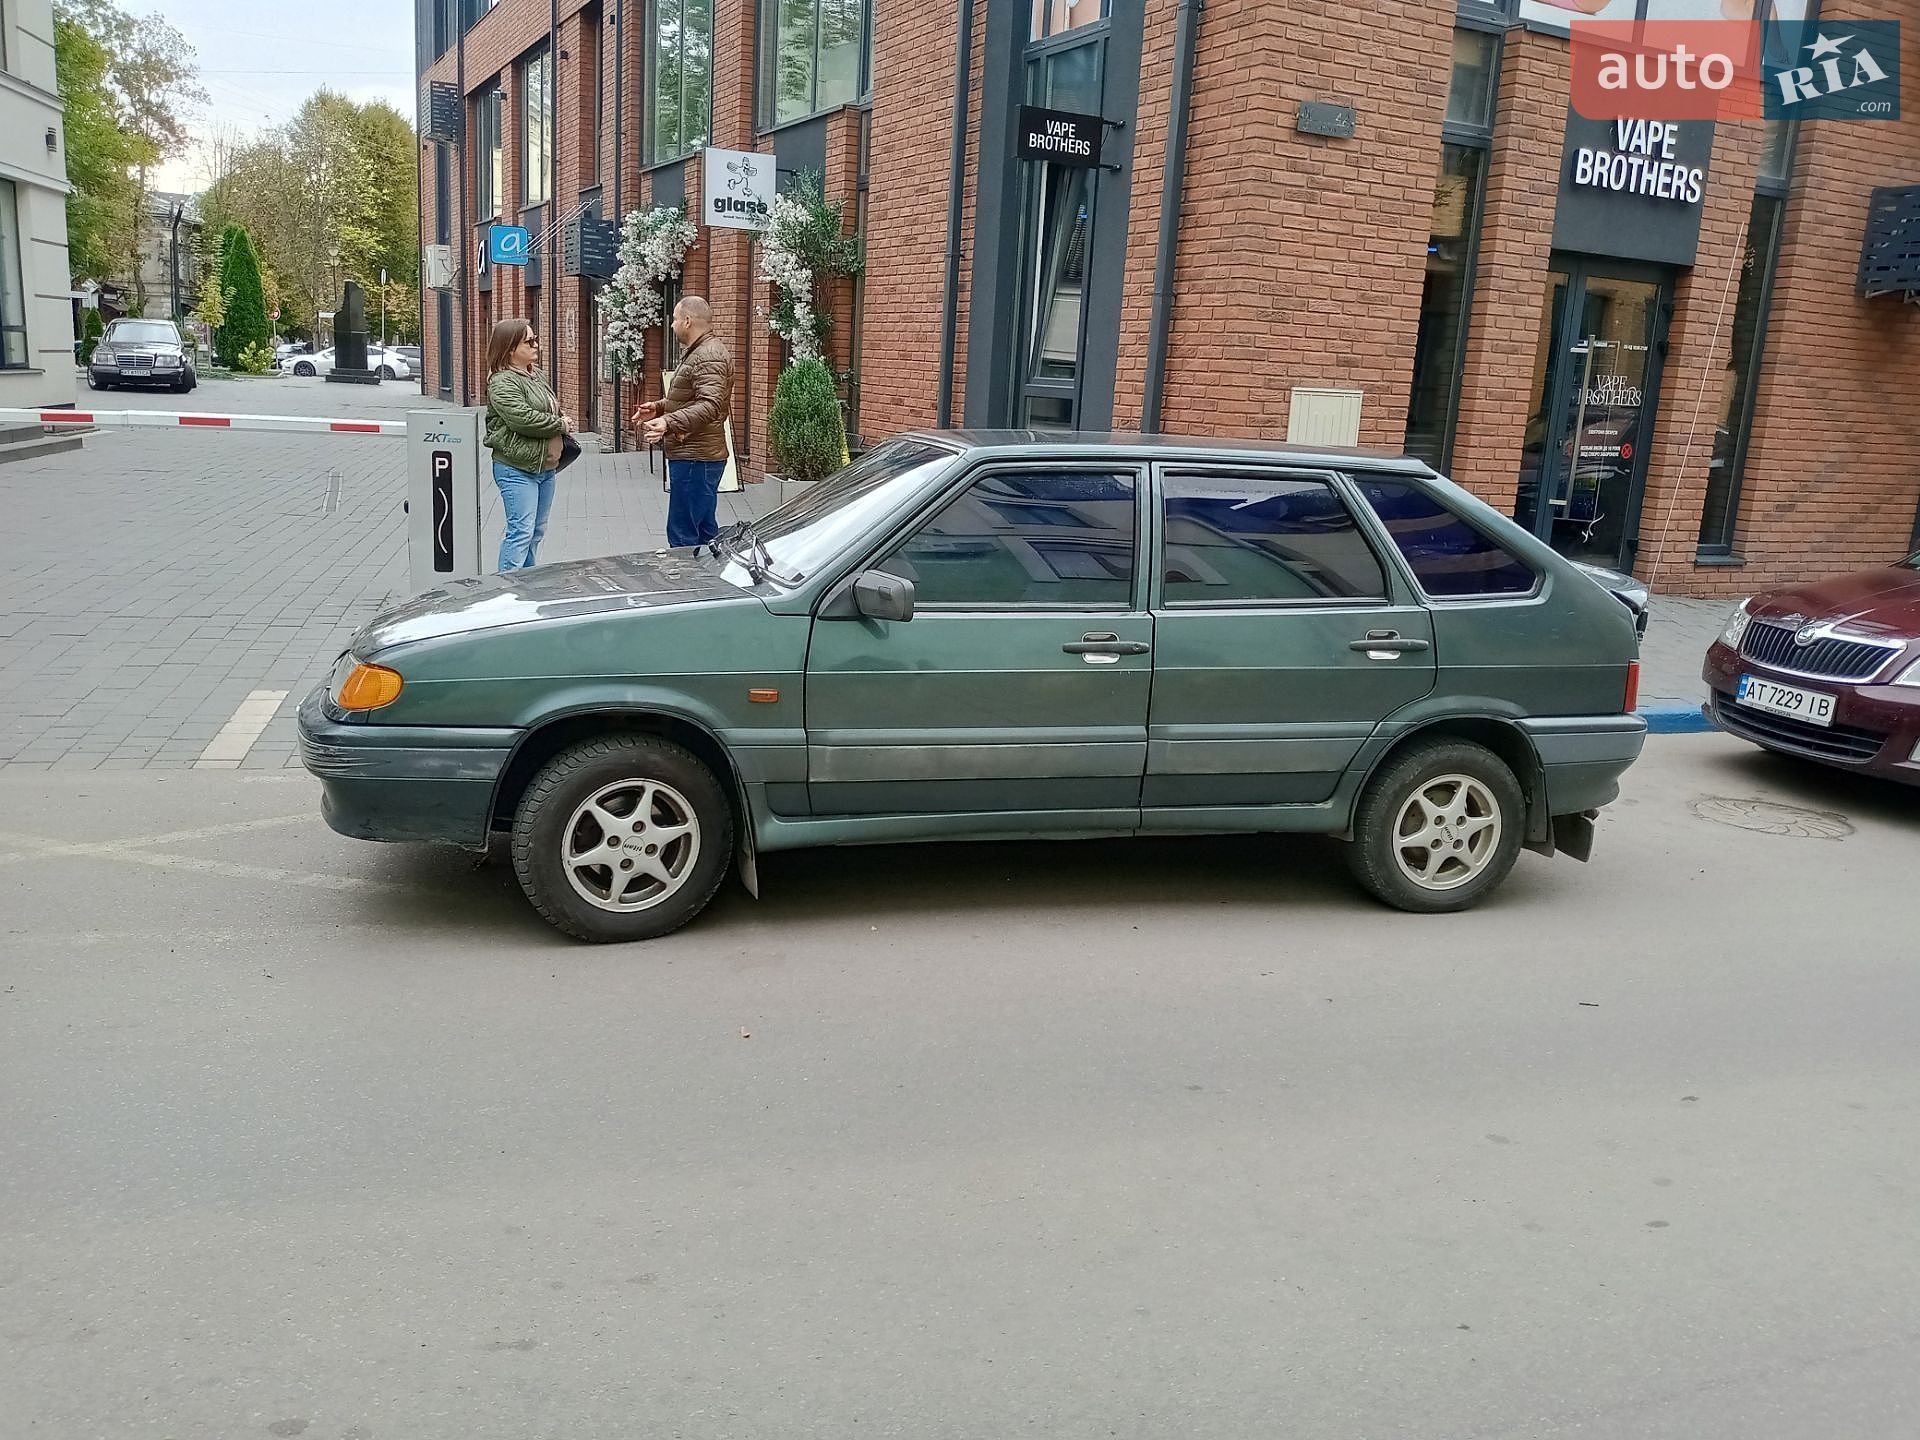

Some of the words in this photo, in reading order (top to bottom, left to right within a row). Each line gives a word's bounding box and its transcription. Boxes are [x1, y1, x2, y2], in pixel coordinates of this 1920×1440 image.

[1046, 119, 1076, 138] VAPE
[1616, 114, 1678, 160] VAPE
[1029, 132, 1091, 156] BROTHERS
[1575, 147, 1703, 203] BROTHERS
[1596, 374, 1628, 391] VAPE
[435, 457, 449, 477] P
[1746, 681, 1767, 701] AT
[1768, 686, 1803, 710] 7229
[1808, 696, 1830, 717] IB
